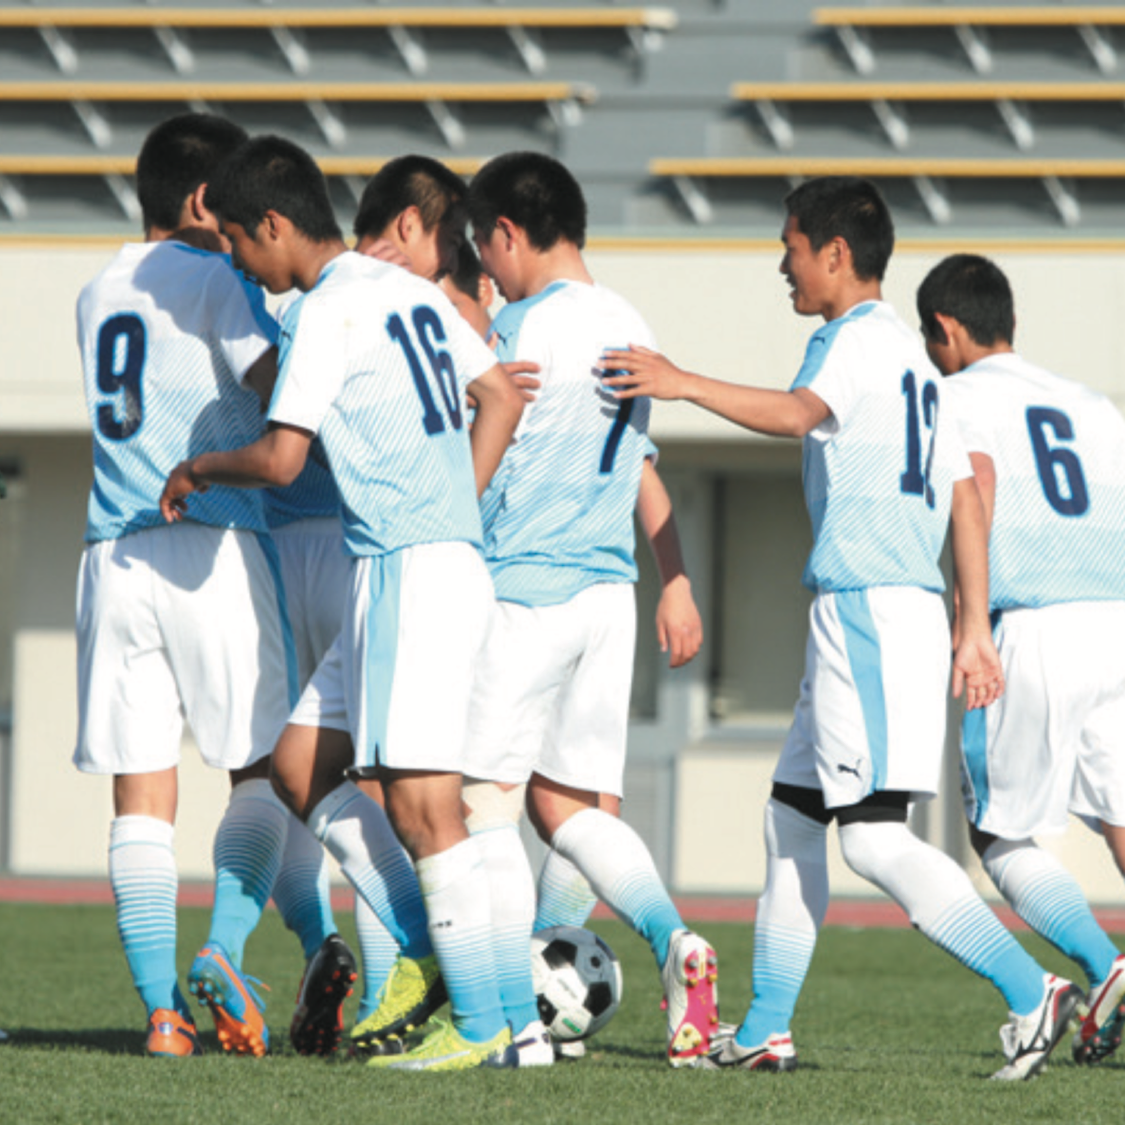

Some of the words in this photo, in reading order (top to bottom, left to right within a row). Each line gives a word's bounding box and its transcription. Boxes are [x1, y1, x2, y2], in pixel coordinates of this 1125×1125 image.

[95, 312, 146, 442] 9
[386, 305, 466, 437] 16
[1026, 406, 1091, 518] 6
